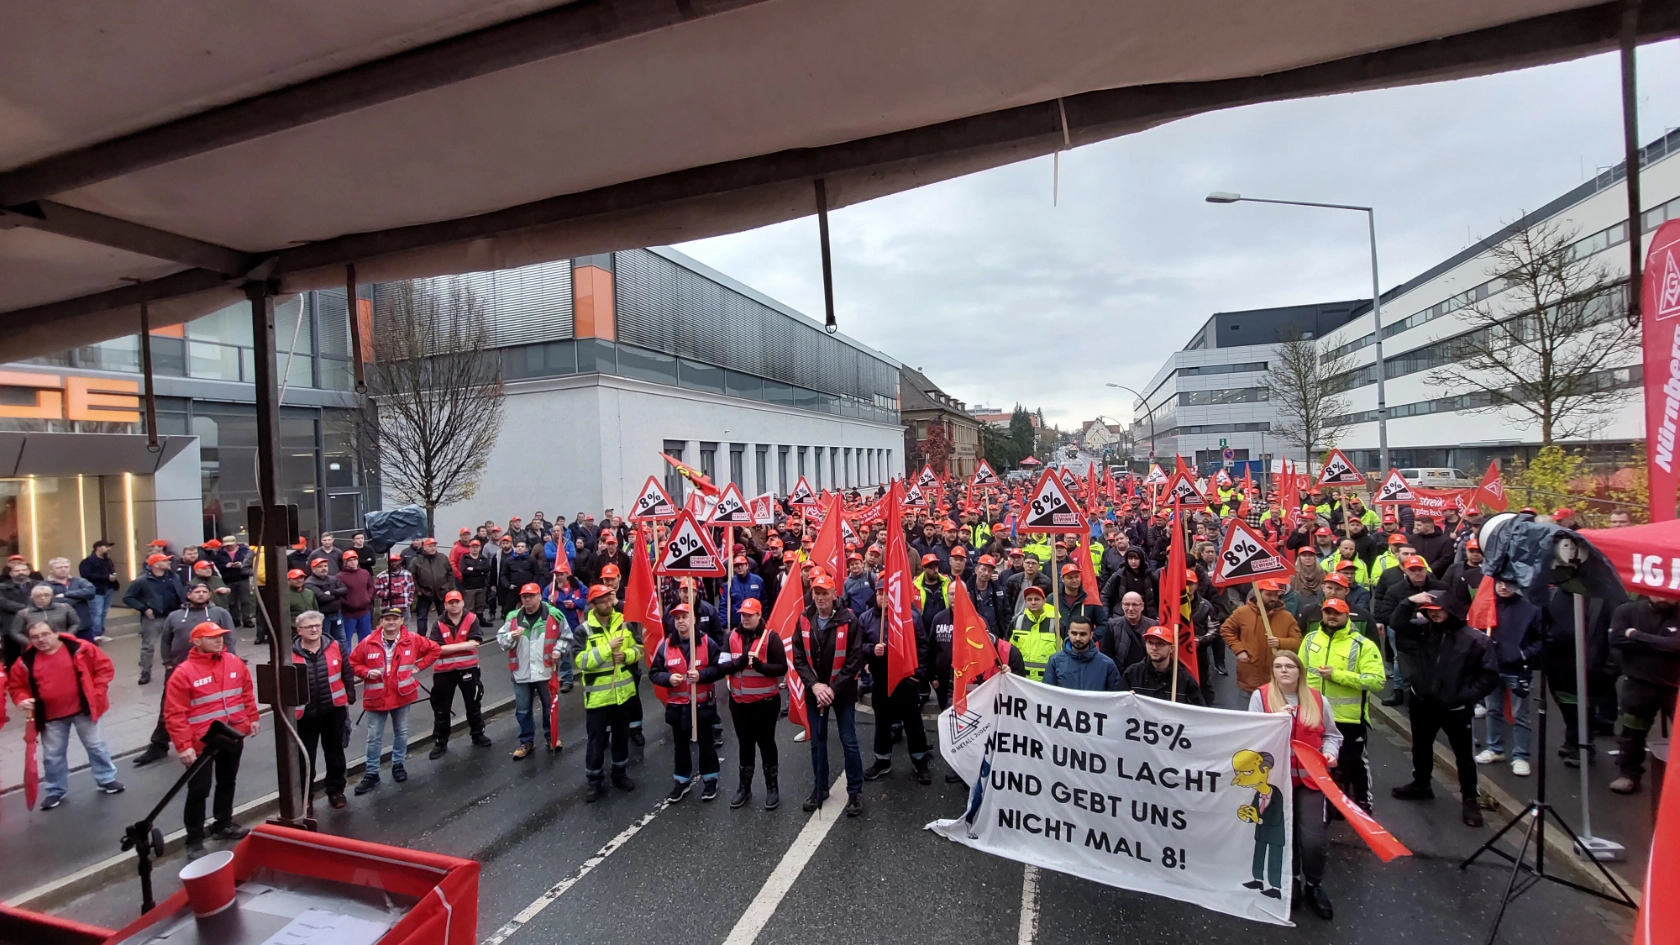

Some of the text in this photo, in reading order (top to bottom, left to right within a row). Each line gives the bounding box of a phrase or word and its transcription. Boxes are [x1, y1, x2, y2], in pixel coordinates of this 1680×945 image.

[1655, 323, 1680, 474] Nürnbe
[976, 469, 989, 480] 8%
[1325, 463, 1345, 477] 8%
[794, 486, 808, 499] 8%
[907, 490, 920, 501] 8%
[1383, 481, 1402, 494] 8%
[640, 491, 661, 509] 8%
[717, 497, 739, 514] 8%
[1031, 491, 1061, 515] 8%
[669, 533, 698, 558] 8%
[1223, 539, 1257, 566] 8%
[1631, 553, 1665, 586] IG
[193, 675, 213, 688] GEBT
[994, 693, 1192, 751] IHR HABT 25%
[1052, 744, 1107, 774] UND
[1117, 757, 1221, 793] LACHT
[991, 769, 1187, 830] UND GEBT UNS
[998, 809, 1186, 870] NICHT MAL 8!
